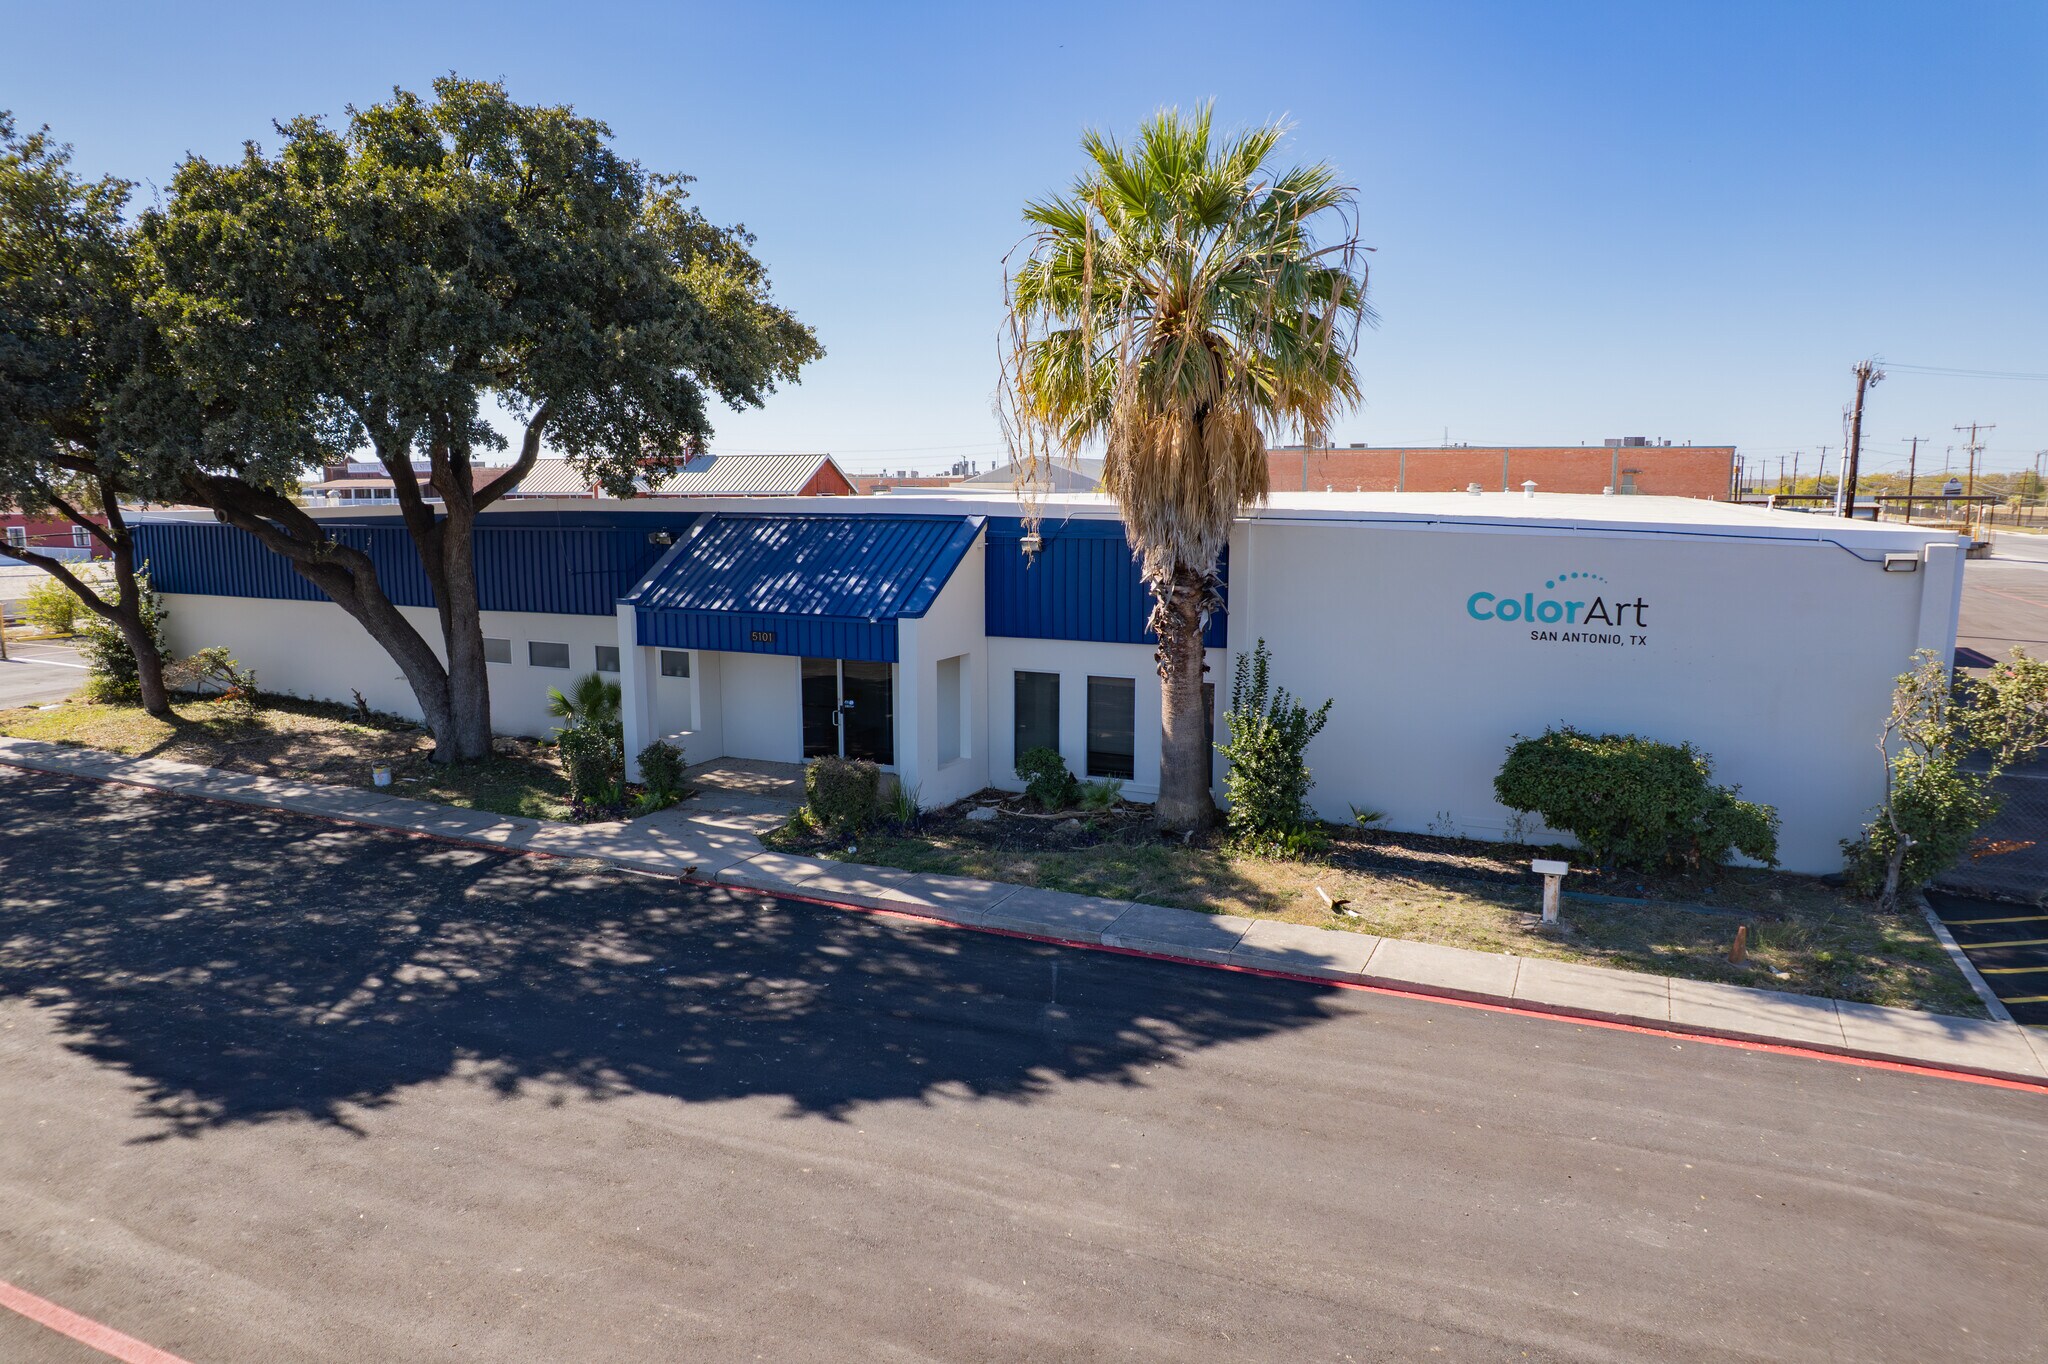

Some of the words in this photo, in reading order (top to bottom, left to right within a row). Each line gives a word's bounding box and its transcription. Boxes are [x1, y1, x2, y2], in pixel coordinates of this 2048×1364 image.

[1467, 591, 1649, 627] ColorArt
[752, 632, 771, 642] 5101
[1530, 630, 1558, 642] SAN
[1562, 632, 1624, 647] ANTONIO,
[1629, 635, 1647, 646] TX
